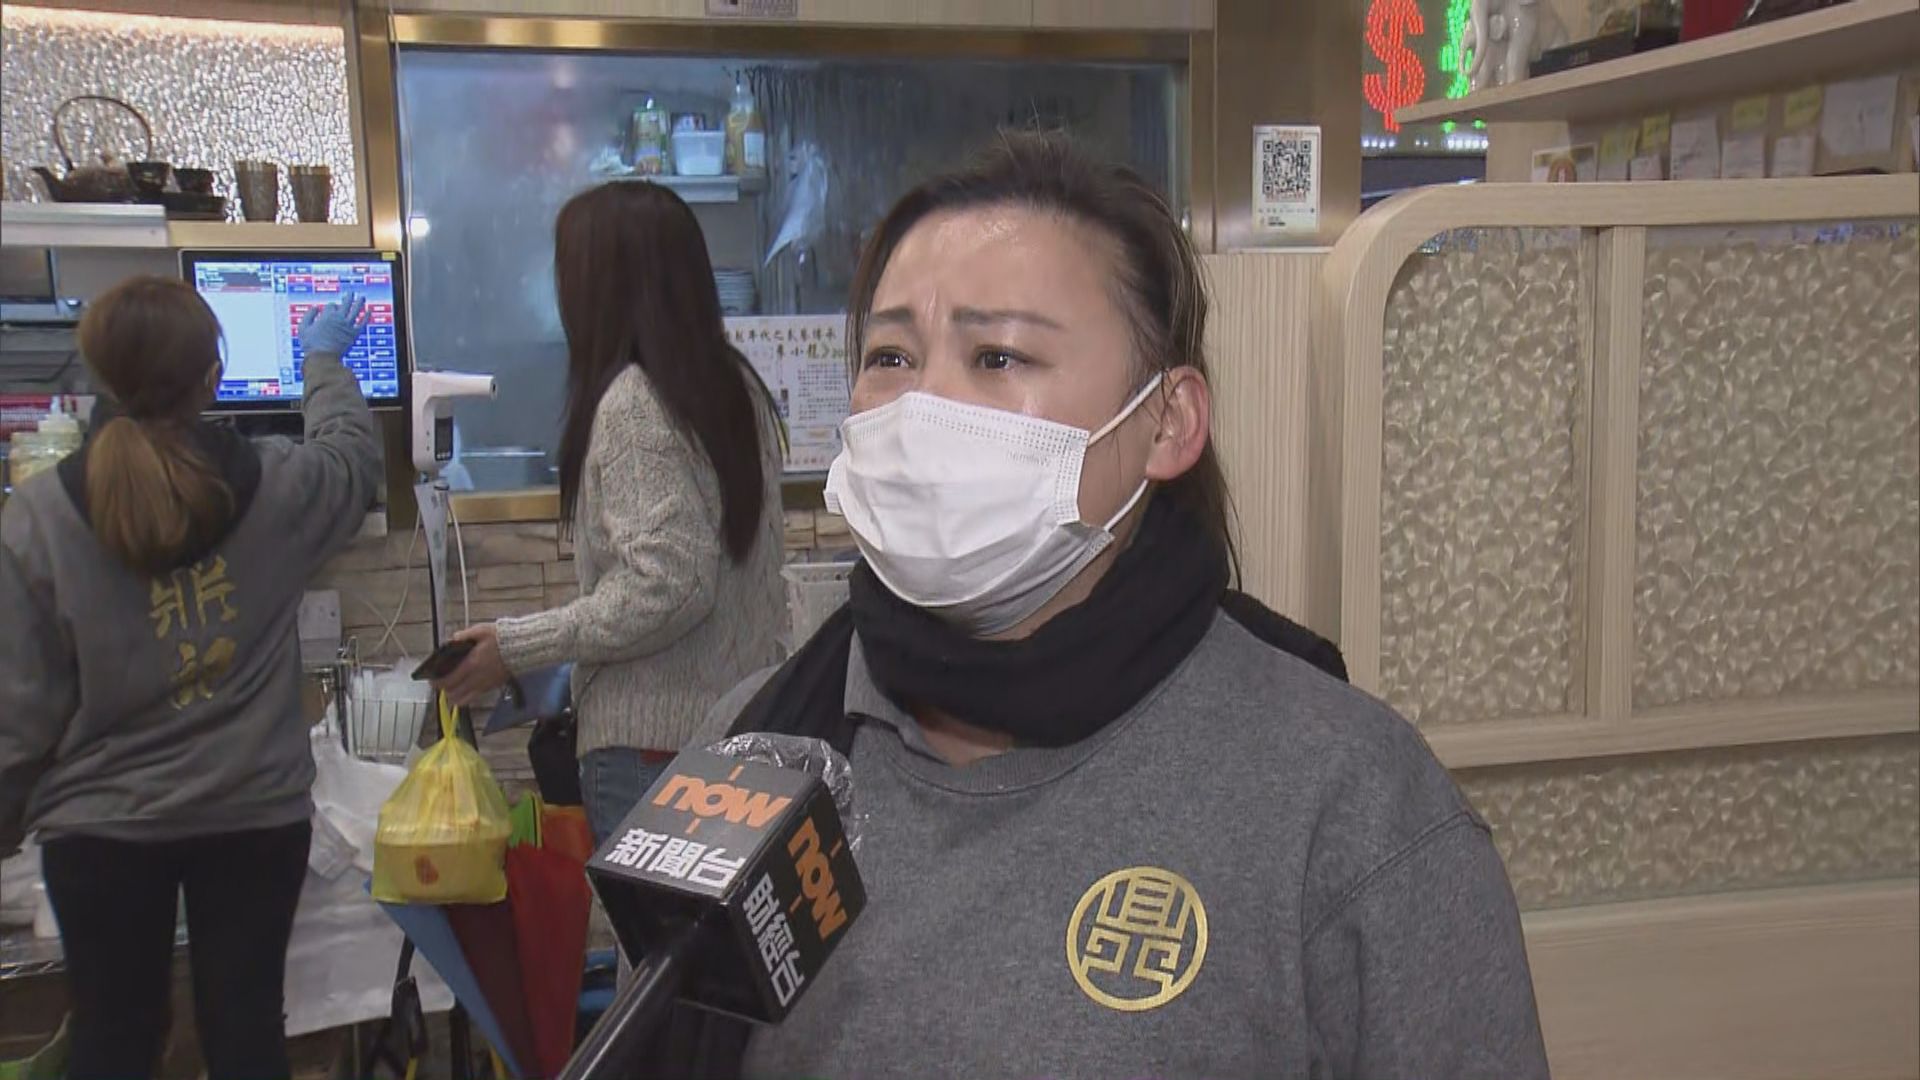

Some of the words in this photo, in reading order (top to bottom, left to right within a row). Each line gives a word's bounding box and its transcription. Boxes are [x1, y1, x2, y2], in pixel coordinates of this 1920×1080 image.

[653, 774, 792, 828] now
[604, 827, 747, 889] 新聞台
[788, 816, 848, 943] now
[742, 872, 805, 1007] 財經台
